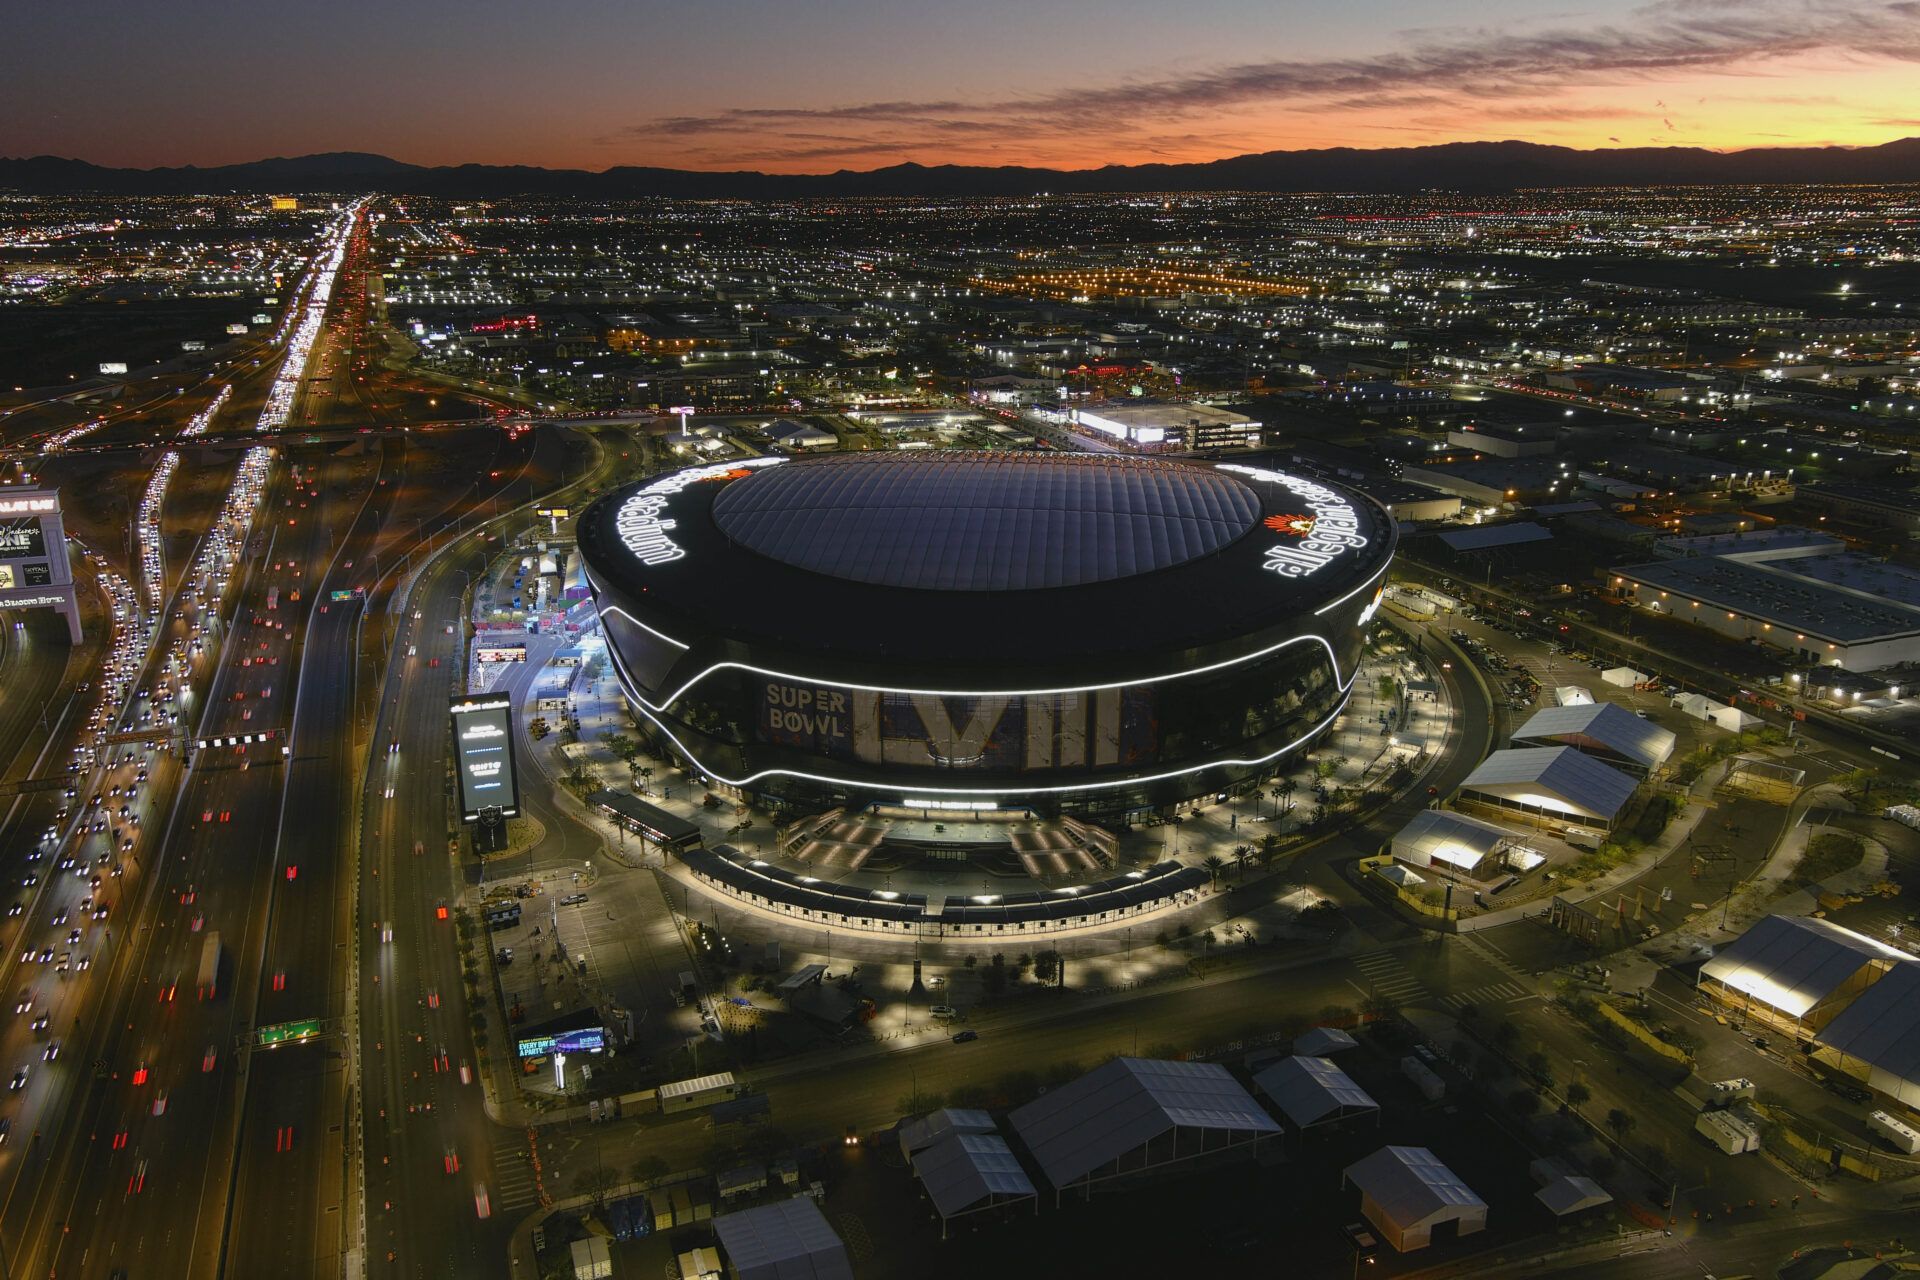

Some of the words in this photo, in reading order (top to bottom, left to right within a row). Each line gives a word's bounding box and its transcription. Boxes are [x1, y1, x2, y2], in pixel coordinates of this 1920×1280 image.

[616, 495, 686, 566] stadium
[1262, 502, 1368, 578] allegiant
[767, 684, 846, 713] SUPER
[770, 708, 845, 737] BOWL
[852, 686, 1121, 768] LVIII
[519, 1042, 537, 1050] EVERY
